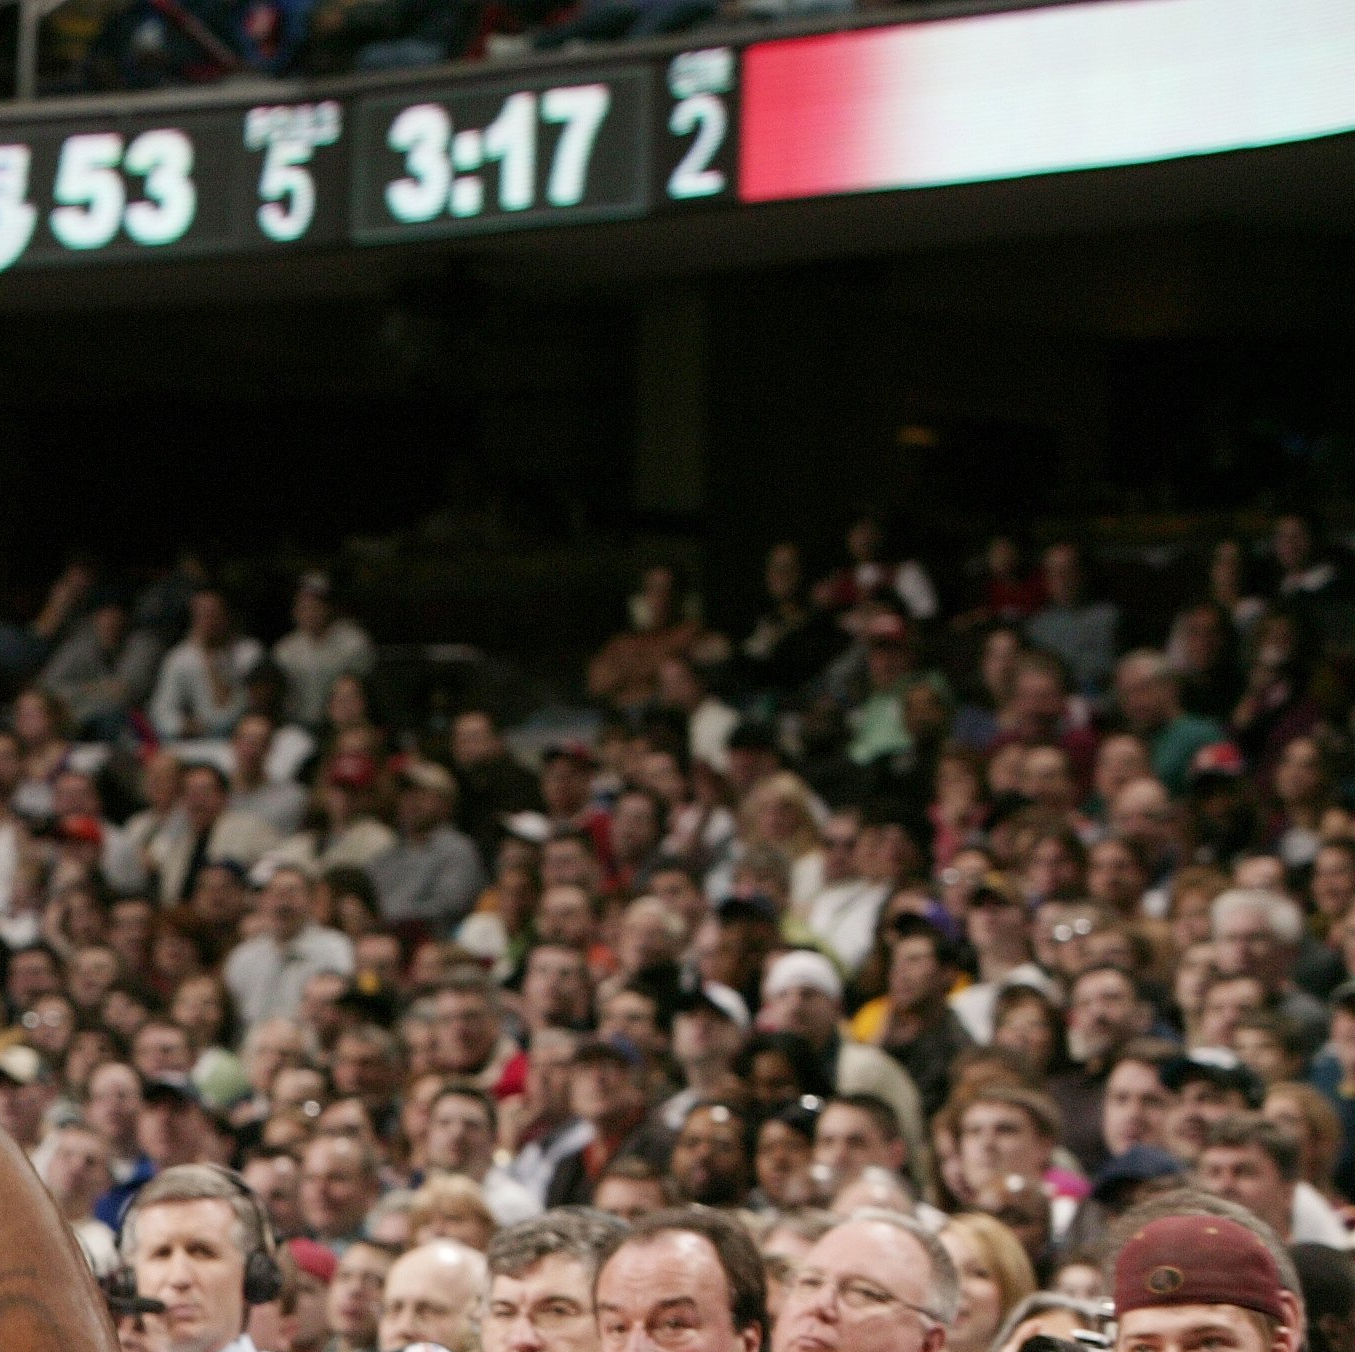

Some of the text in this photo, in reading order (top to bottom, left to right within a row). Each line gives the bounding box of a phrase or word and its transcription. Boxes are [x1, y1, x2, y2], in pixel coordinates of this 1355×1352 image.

[52, 129, 196, 251] 53
[257, 142, 317, 243] 5
[385, 85, 609, 223] 3:17
[667, 93, 728, 200] 2
